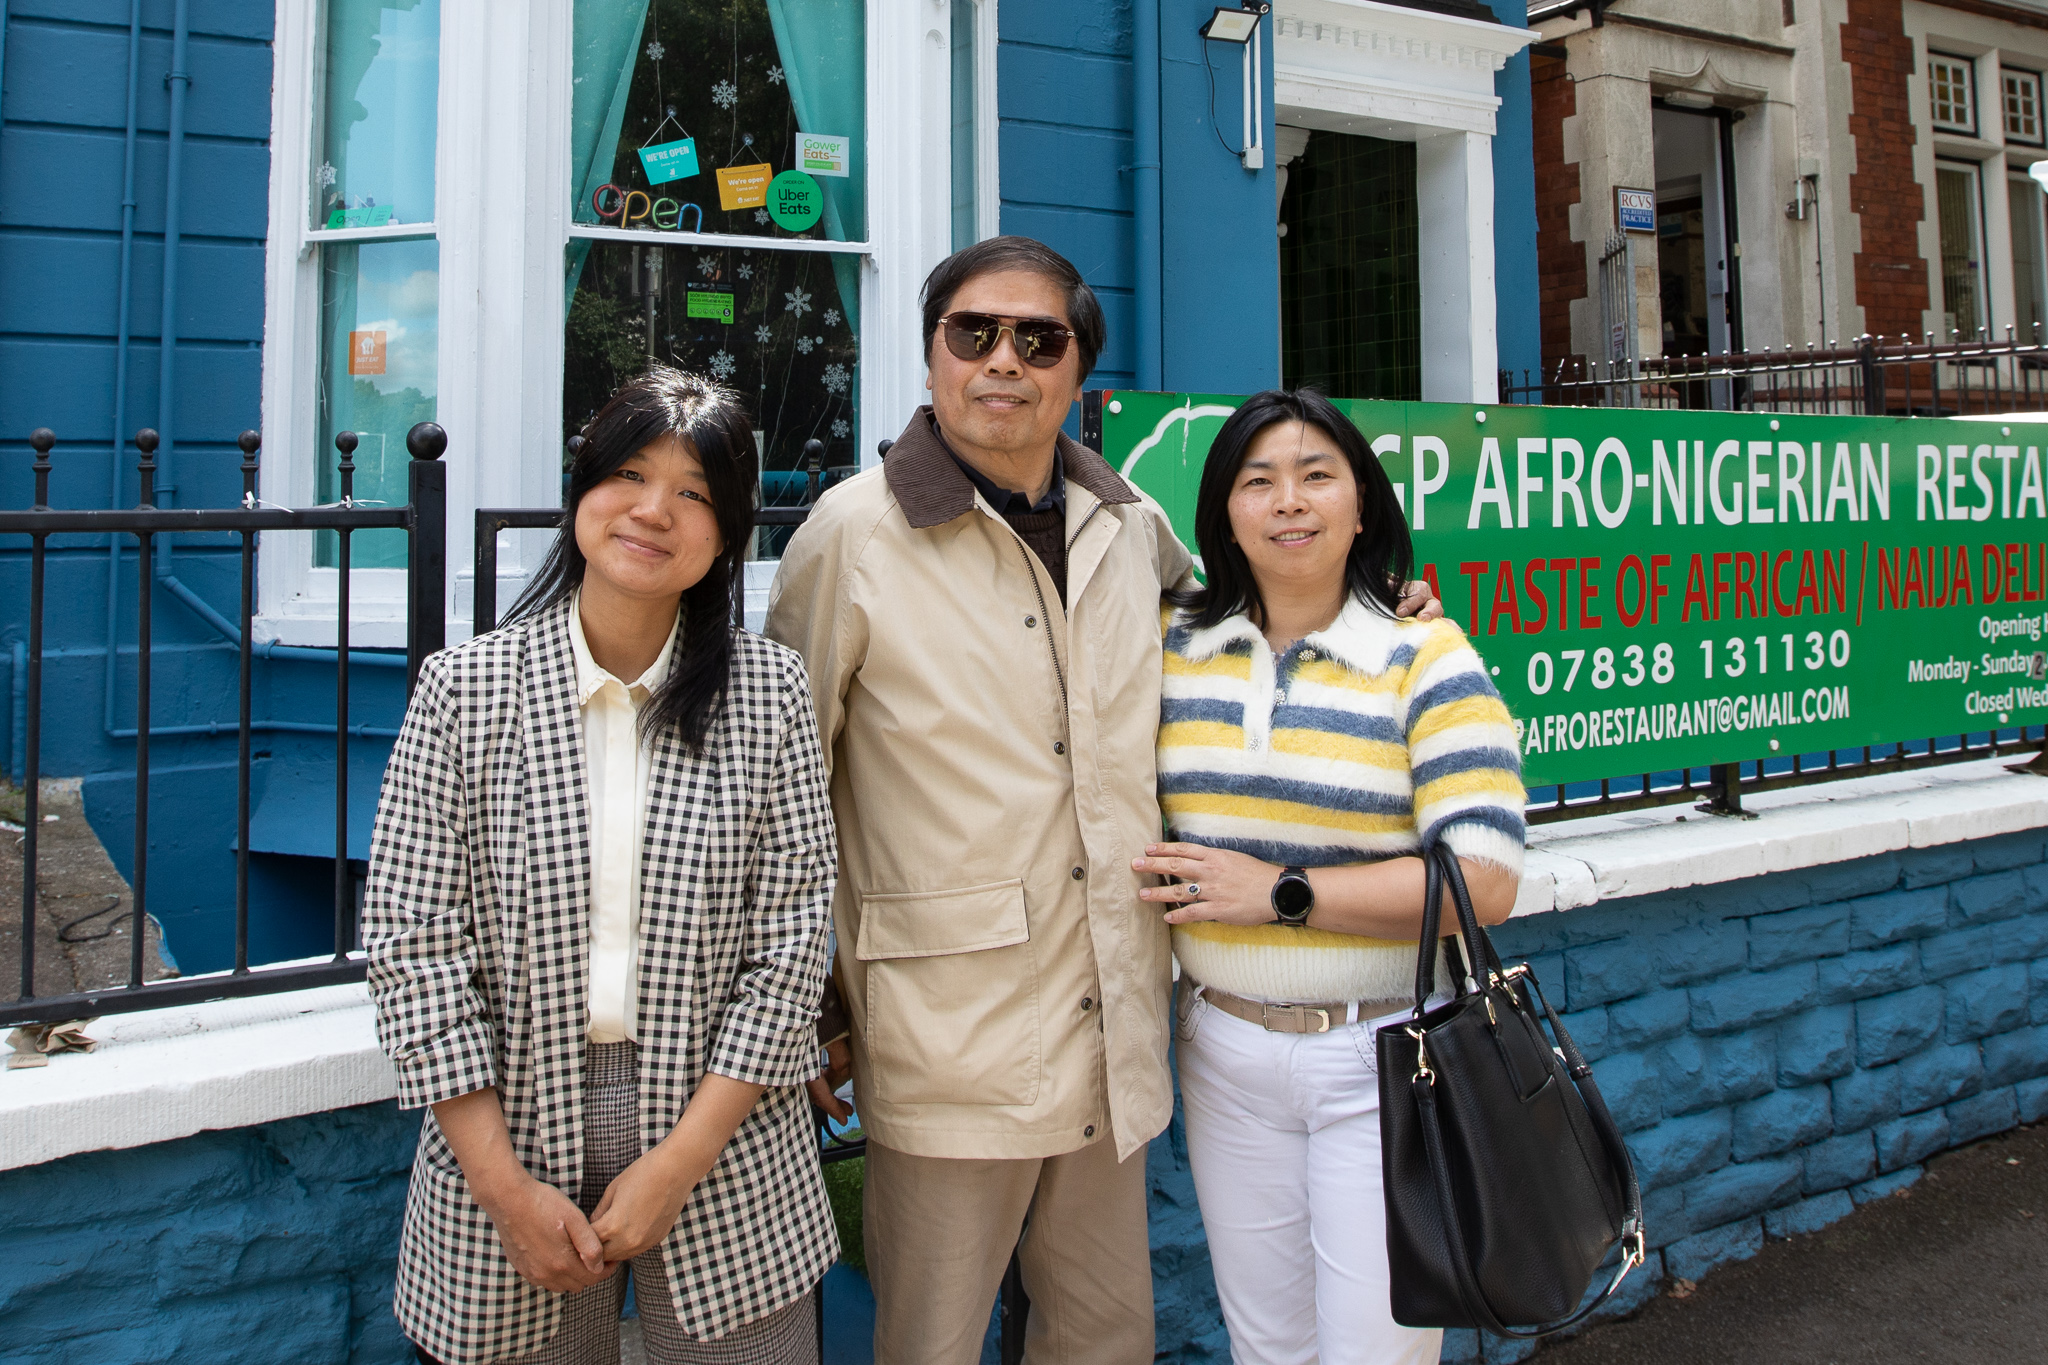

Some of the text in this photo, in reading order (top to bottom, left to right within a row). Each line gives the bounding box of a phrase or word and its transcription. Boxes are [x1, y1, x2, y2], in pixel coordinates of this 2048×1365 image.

[645, 145, 690, 162] WE'RE OPEN
[804, 139, 841, 153] Gower
[804, 148, 830, 160] Eats
[727, 178, 747, 186] We're
[778, 188, 810, 201] Uber
[1621, 193, 1652, 209] RCVS
[779, 202, 811, 215] Eats
[1622, 213, 1652, 224] PRACTICE
[1467, 436, 1890, 529] AFRO-NIGERIAN
[1917, 444, 2048, 522] RESTA
[1460, 556, 1602, 637] TASTE
[1614, 553, 1671, 628] OF
[1680, 548, 1847, 625] AFRICAN
[1853, 540, 1869, 626] /
[1877, 545, 1974, 611] NAIJA
[1982, 543, 2048, 605] DELI
[1979, 612, 2041, 644] Opening
[1527, 642, 1676, 696] 07838
[1699, 629, 1850, 679] 131130
[1907, 655, 1971, 684] Monday
[1981, 649, 2035, 678] Sunday
[1965, 687, 2014, 715] Closed
